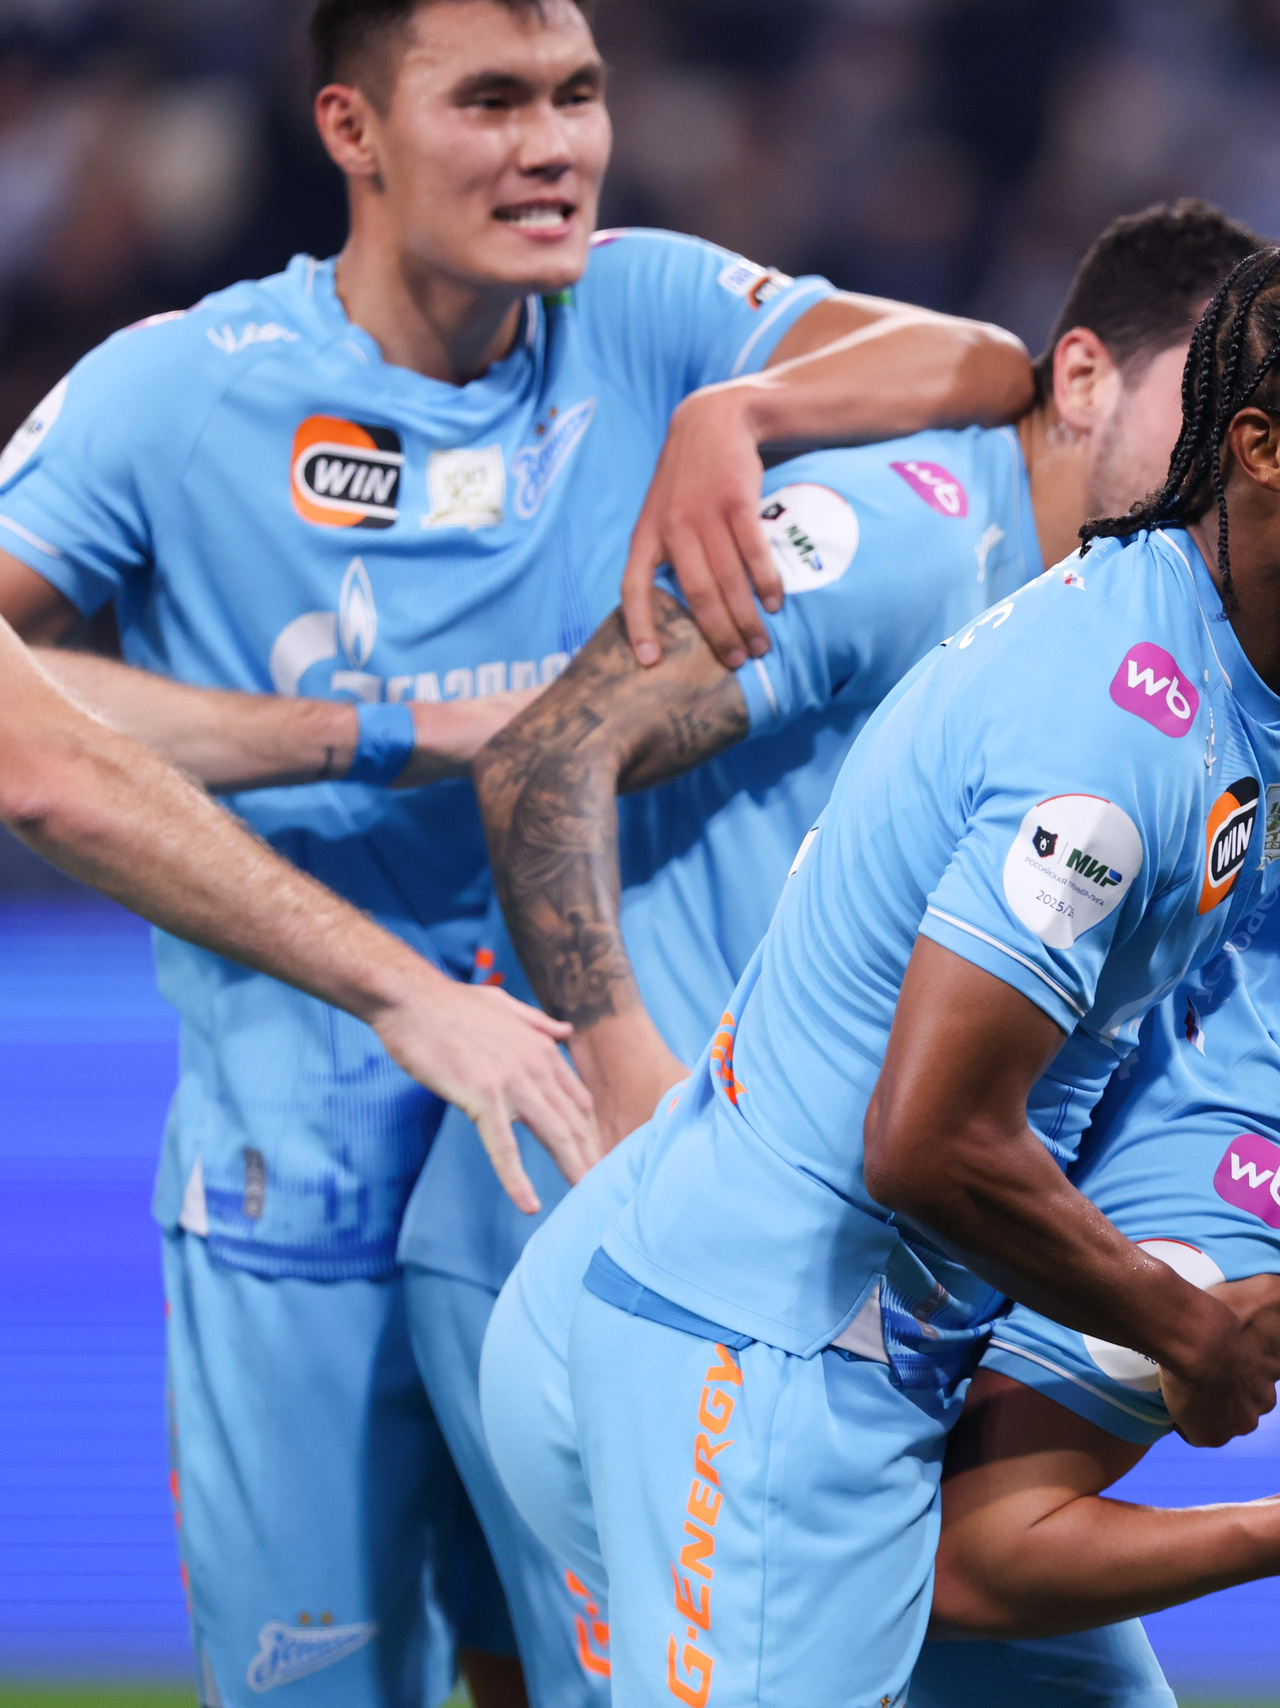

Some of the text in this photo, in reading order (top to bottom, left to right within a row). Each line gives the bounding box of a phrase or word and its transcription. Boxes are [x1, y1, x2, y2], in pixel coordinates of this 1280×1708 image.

[313, 457, 398, 504] WIN
[1127, 659, 1191, 720] wb
[1066, 848, 1123, 888] МИР
[1216, 817, 1254, 873] WIN
[1025, 856, 1067, 886] РОССИЙСКАЯ
